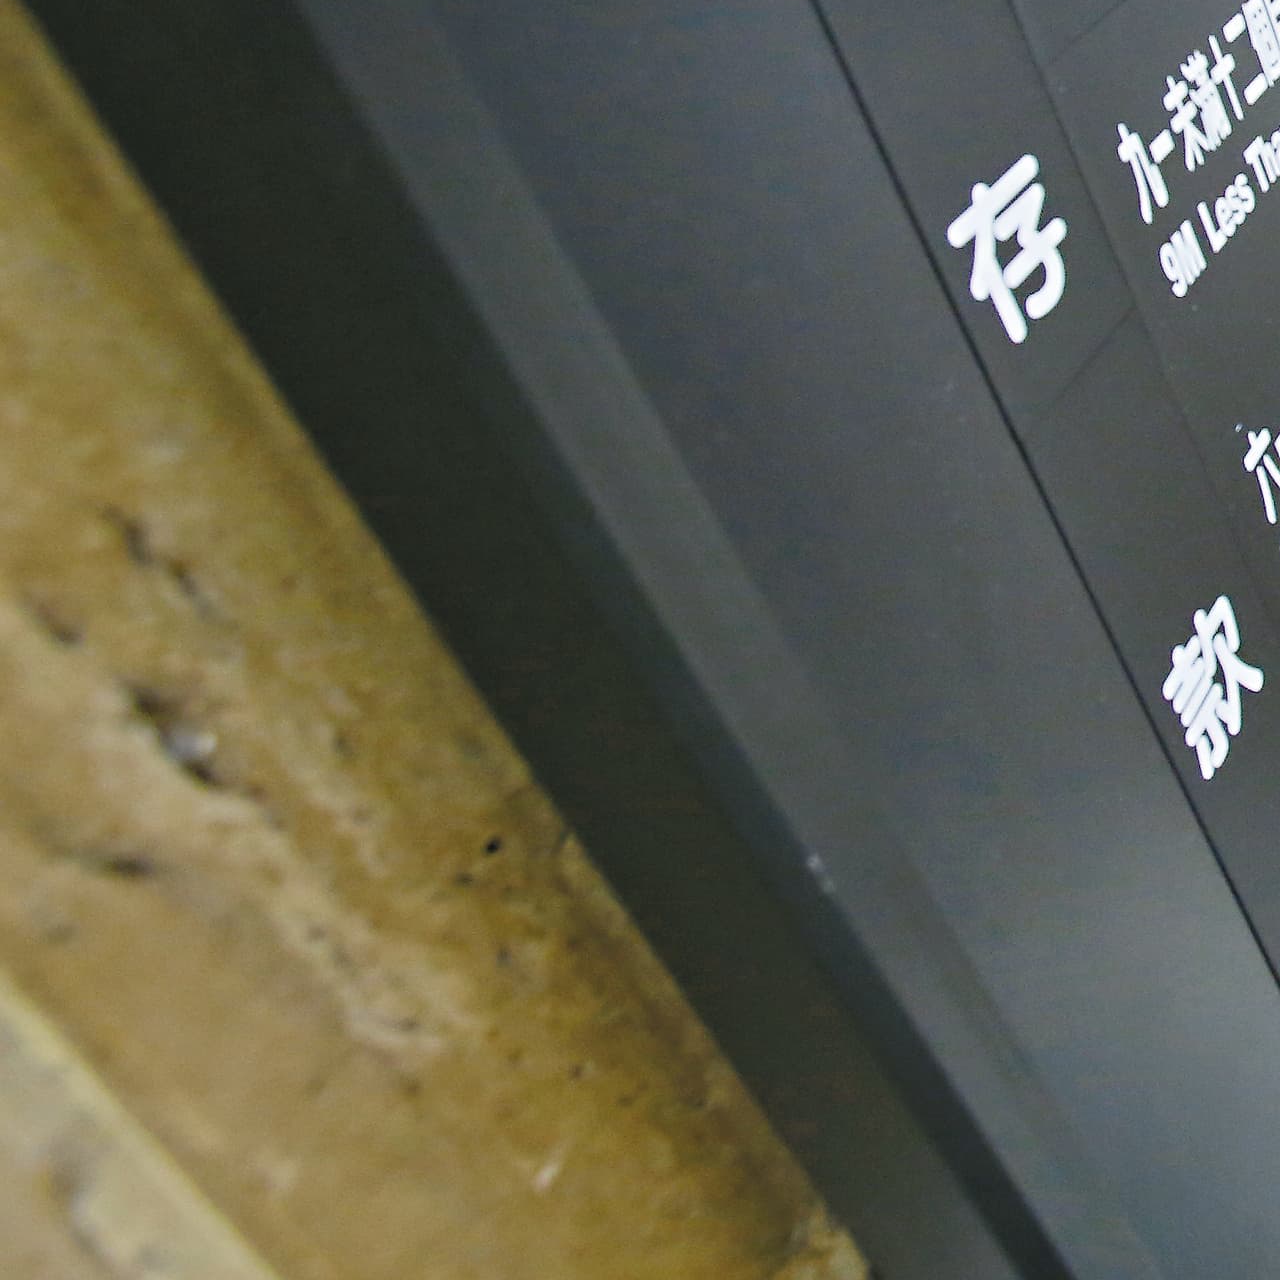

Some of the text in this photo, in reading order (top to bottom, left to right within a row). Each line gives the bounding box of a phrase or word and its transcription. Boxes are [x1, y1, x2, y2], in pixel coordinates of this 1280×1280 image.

[946, 153, 1067, 344] 存
[1197, 172, 1256, 254] Less
[1161, 594, 1266, 781] 款
